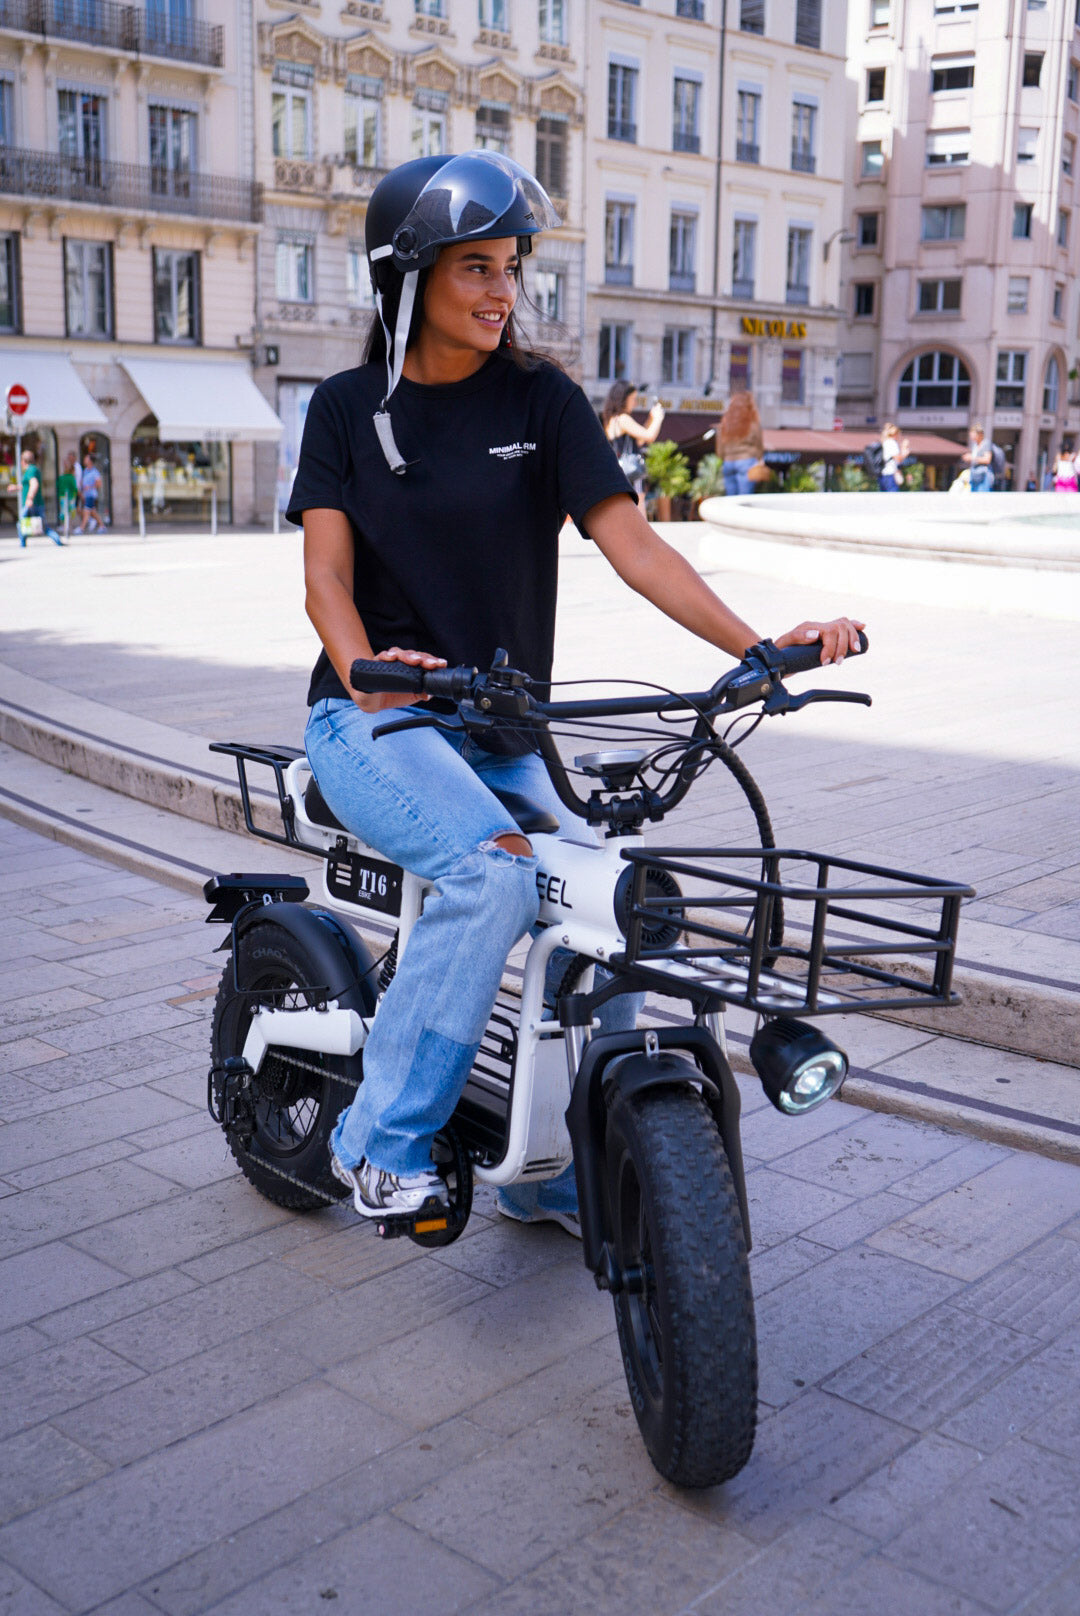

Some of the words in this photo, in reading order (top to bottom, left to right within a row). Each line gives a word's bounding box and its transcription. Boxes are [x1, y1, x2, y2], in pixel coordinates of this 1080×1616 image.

[740, 316, 808, 339] NICOLAS
[488, 442, 522, 455] MINIMAL
[359, 868, 388, 897] T16
